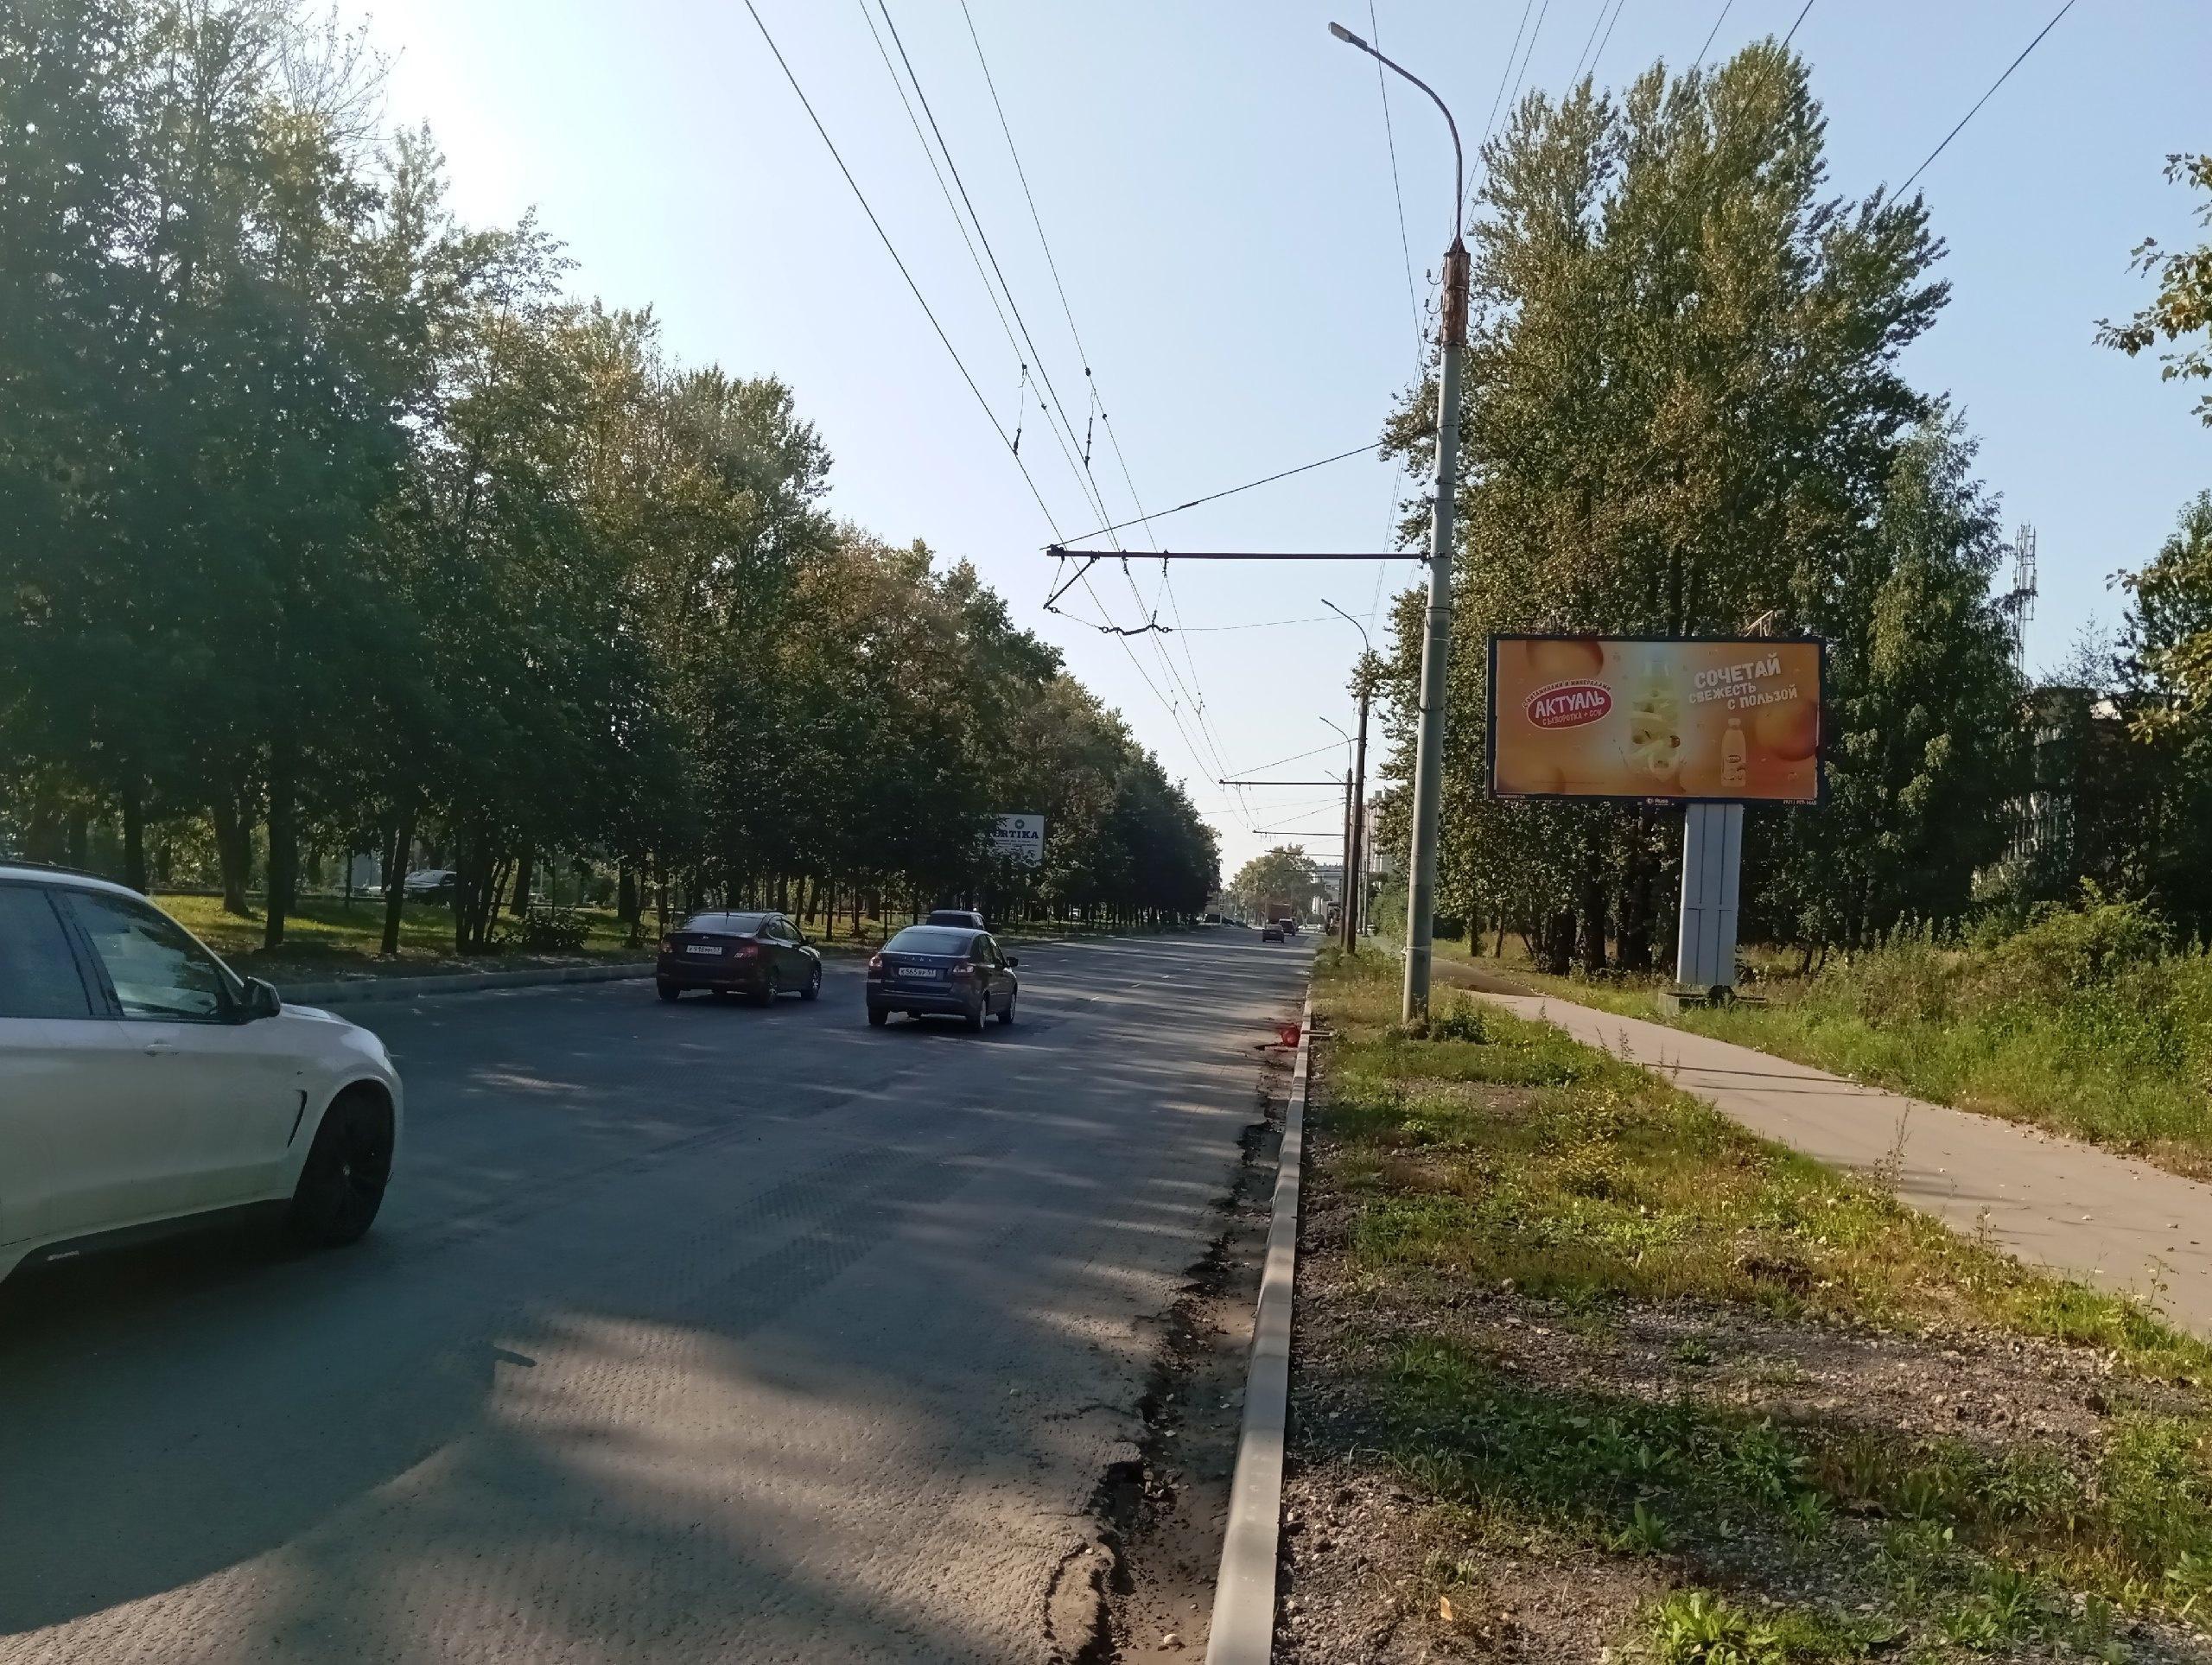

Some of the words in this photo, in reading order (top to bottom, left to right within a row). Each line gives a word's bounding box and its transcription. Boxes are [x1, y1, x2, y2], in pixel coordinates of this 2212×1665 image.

[1694, 651, 1782, 689] СОЧЕТАЙ
[1535, 690, 1605, 718] АКТУАЛЬ
[1688, 682, 1757, 704] СВЕЖЕСТЬ
[1727, 698, 1736, 710] С
[1739, 683, 1798, 709] ПОЛЬЗОЙ
[1542, 712, 1582, 725] СЫВОРОТКА
